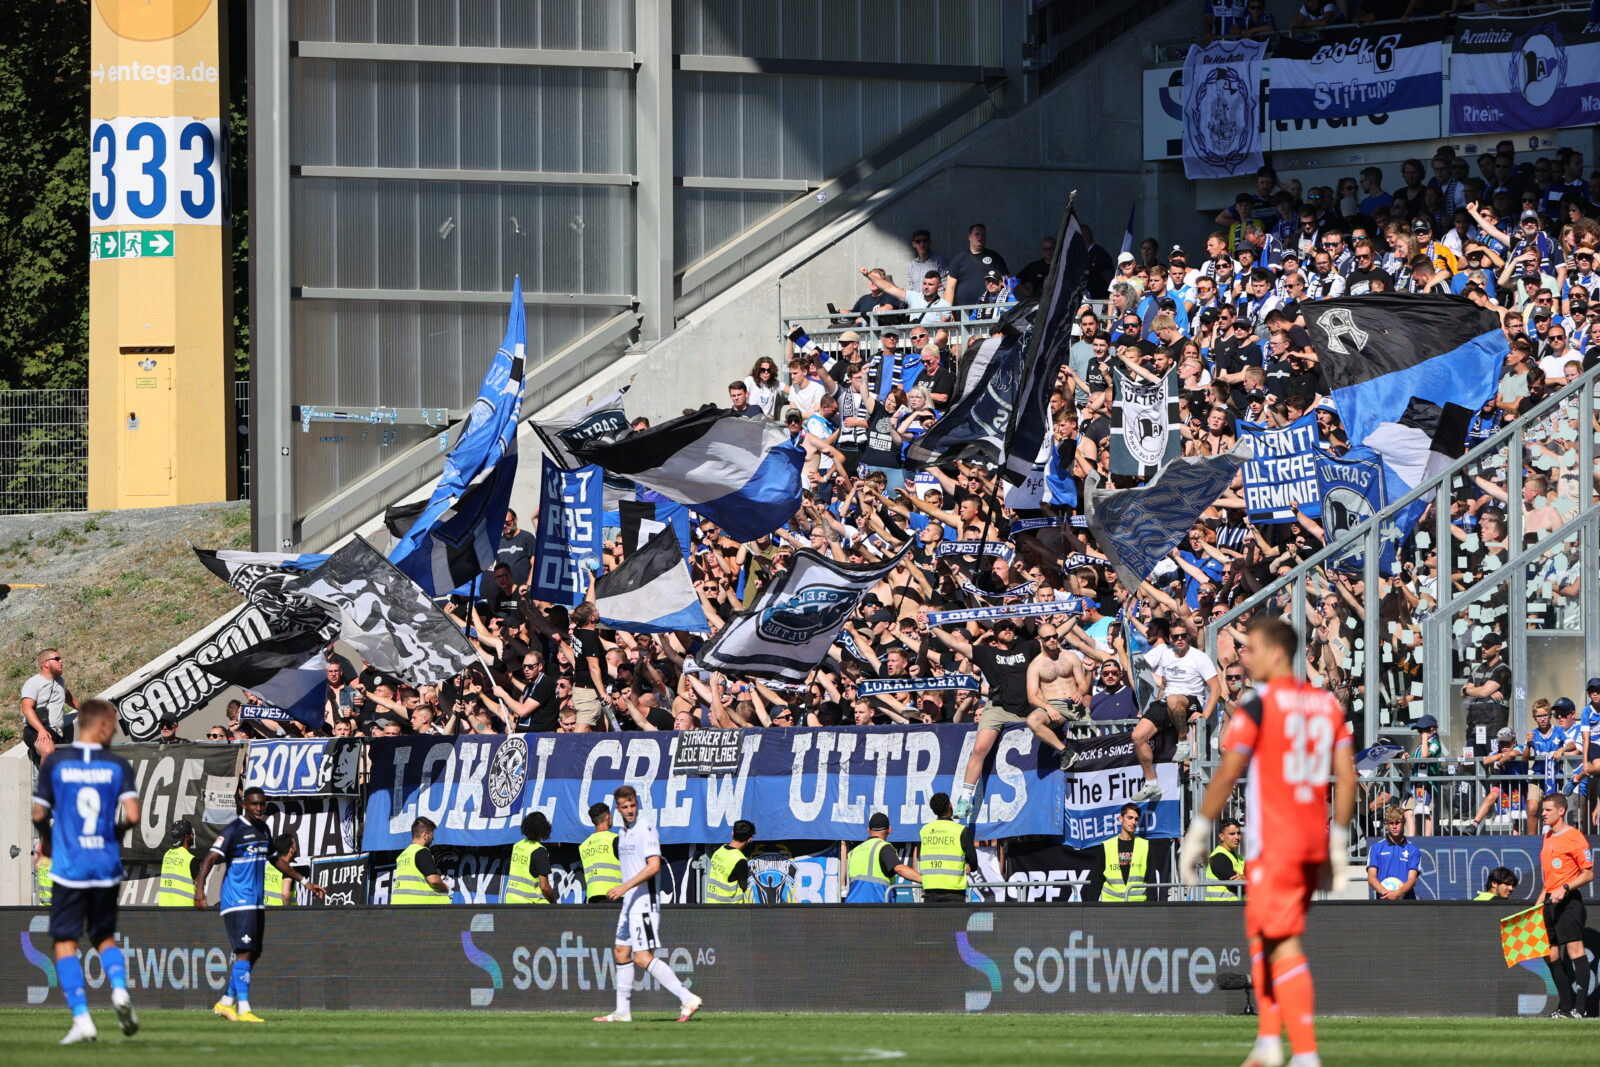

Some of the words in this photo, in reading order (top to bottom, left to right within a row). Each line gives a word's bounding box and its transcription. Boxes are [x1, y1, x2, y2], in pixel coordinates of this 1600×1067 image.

[1459, 28, 1513, 44] Arminia
[108, 61, 218, 85] entega.de
[1463, 105, 1505, 122] Rhein-
[1244, 453, 1316, 484] ULTRAS
[1321, 464, 1371, 488] ULTRAS
[1247, 479, 1320, 510] ARMINIA
[546, 503, 593, 541] RAS
[940, 542, 1008, 556] OSTWESTALEN
[935, 609, 999, 623] LOKAL
[1018, 601, 1077, 616] CREW
[930, 675, 968, 688] CREW
[721, 730, 739, 746] ALS
[1283, 712, 1334, 786] 33
[699, 746, 738, 762] AUFLAGE
[1108, 743, 1134, 757] SINCE
[245, 744, 323, 793] BOYS
[390, 738, 557, 833] LOKL
[1066, 777, 1102, 805] The
[77, 786, 101, 836] 9
[922, 836, 955, 846] ORDNER
[332, 864, 365, 885] LIPPE
[635, 926, 642, 941] 2
[77, 931, 228, 990] otware
[696, 947, 716, 966] AG
[1013, 930, 1217, 994] software
[1219, 947, 1241, 967] AG
